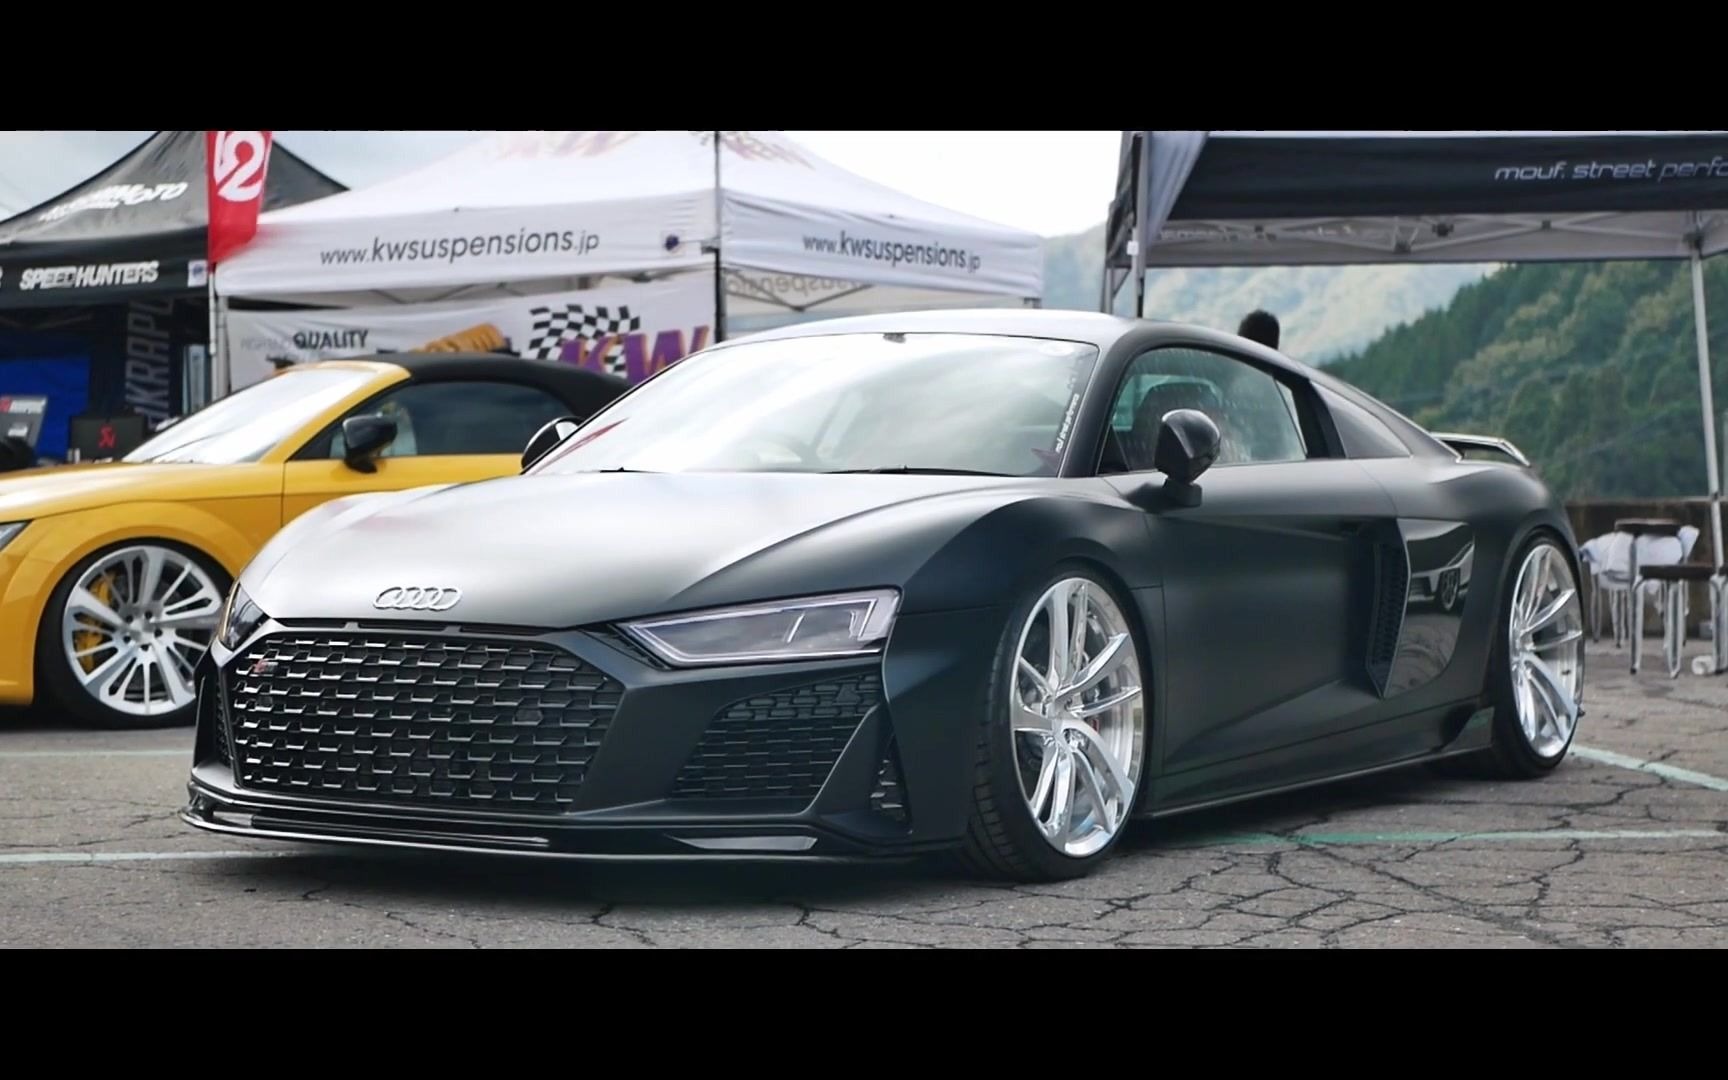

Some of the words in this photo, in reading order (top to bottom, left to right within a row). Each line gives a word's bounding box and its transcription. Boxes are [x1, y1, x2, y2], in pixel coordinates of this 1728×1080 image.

[1494, 160, 1566, 181] mouf.
[1572, 158, 1656, 180] street
[320, 226, 600, 267] www.kwsuspensions.jp
[803, 231, 981, 274] www.kwsuspensions.jp
[19, 259, 160, 291] SPEEDHUNTERS
[293, 328, 370, 350] QUALITY
